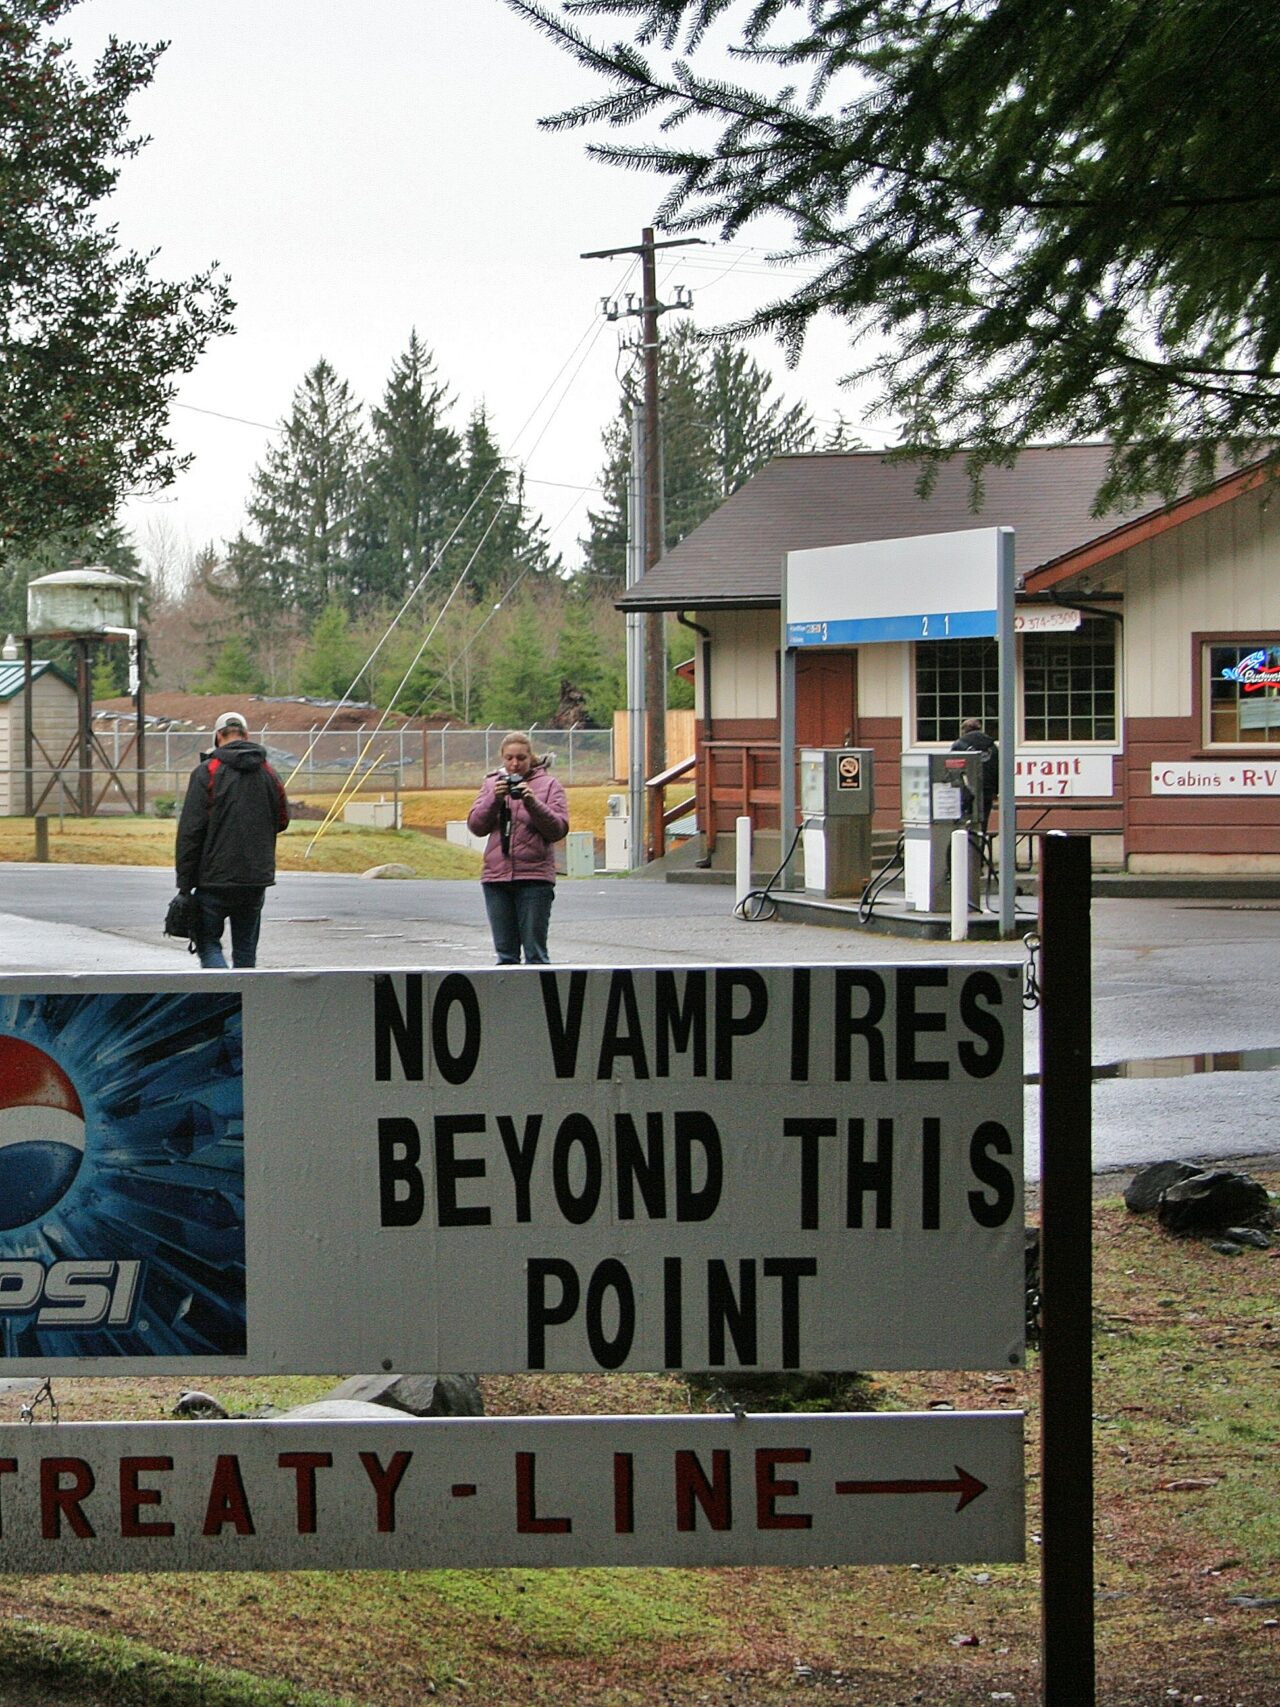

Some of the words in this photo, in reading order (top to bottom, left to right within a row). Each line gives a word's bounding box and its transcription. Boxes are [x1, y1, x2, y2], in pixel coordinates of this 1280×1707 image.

[821, 622, 828, 641] 3
[922, 616, 929, 636] 2
[944, 615, 949, 635] 1
[374, 972, 482, 1085] NO
[539, 968, 1006, 1084] VAMPIRES
[377, 1111, 723, 1228] BEYOND
[783, 1116, 1015, 1230] THIS
[527, 1256, 818, 1370] POINT
